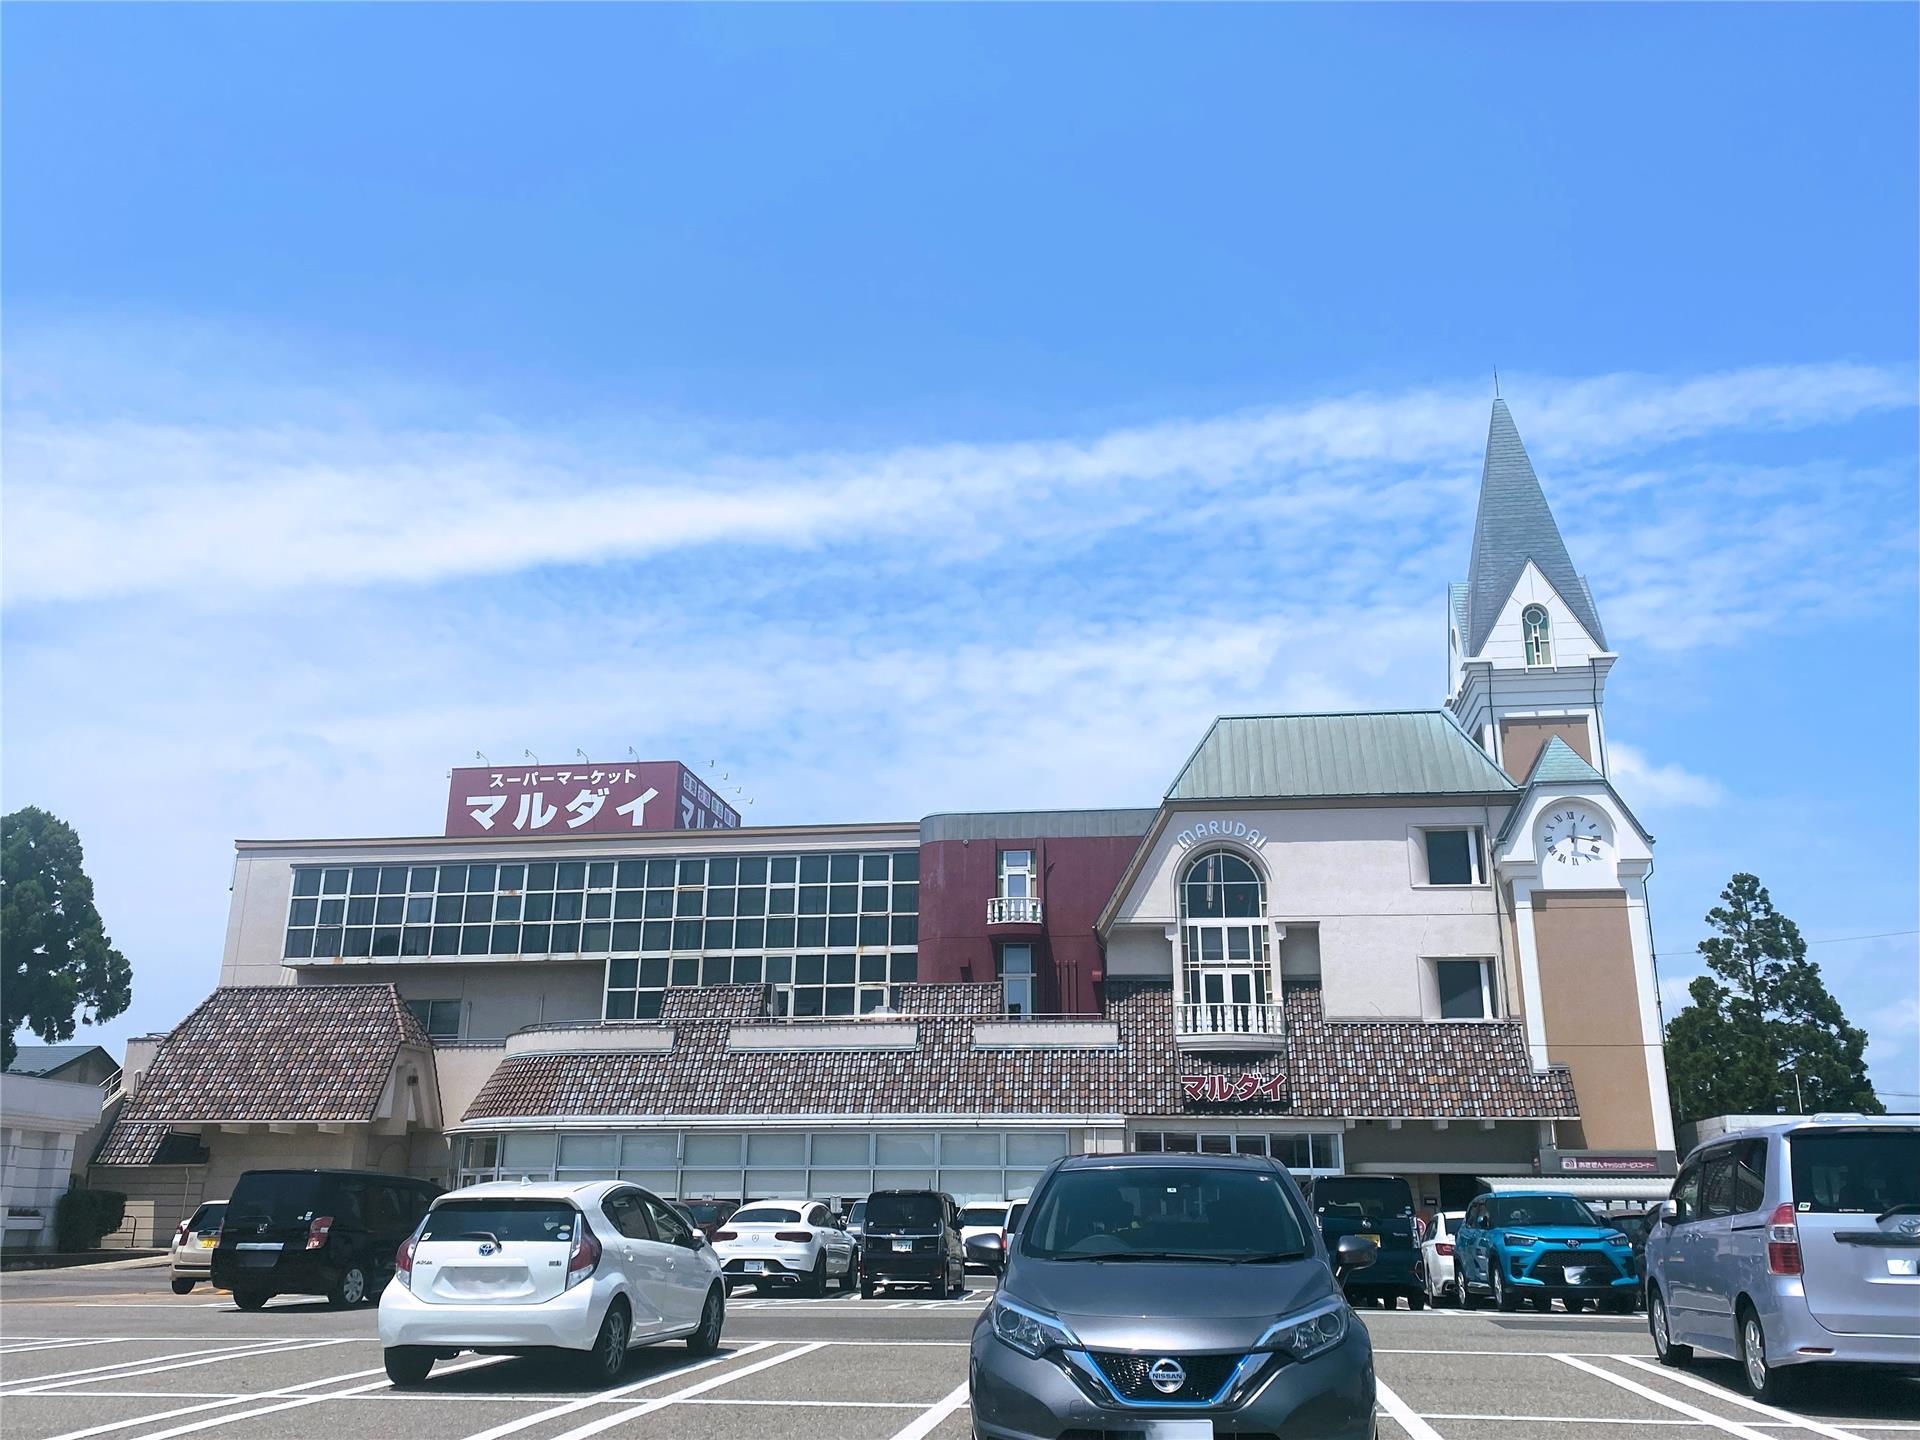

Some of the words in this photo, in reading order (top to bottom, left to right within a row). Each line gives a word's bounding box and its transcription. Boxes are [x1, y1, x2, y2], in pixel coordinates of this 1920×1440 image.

[489, 769, 637, 788] スーパーマーケット
[465, 787, 660, 831] マルダイ
[681, 795, 723, 829] マル
[1177, 820, 1267, 849] MARUDAI
[1181, 1072, 1286, 1101] マルダイ
